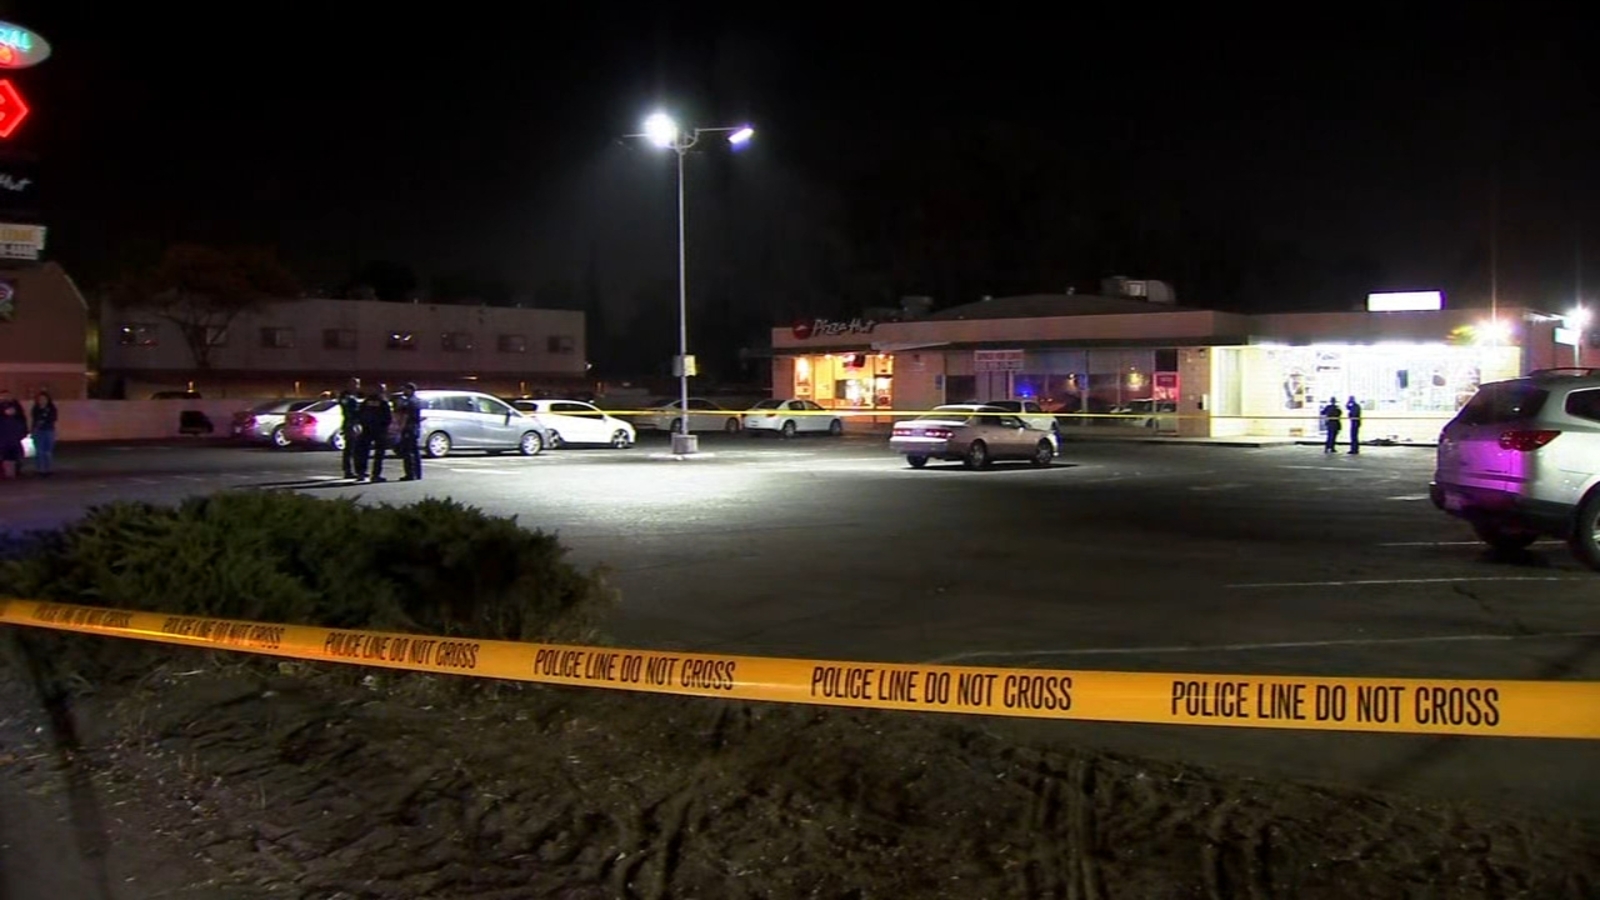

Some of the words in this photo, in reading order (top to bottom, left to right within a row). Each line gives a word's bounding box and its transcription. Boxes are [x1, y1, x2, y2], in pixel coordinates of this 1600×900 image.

[812, 319, 848, 336] Pizza
[849, 318, 877, 334] Hut
[162, 616, 197, 637] POLICE
[249, 625, 285, 649] CROSS
[324, 632, 364, 657] POLICE
[363, 635, 391, 660] LINE
[390, 638, 410, 662] DO
[408, 639, 436, 665] NOT
[435, 641, 480, 669] CROSS
[534, 649, 585, 678] POLICE
[585, 652, 619, 681] LINE
[620, 655, 643, 683] DO
[645, 657, 680, 686] NOT
[680, 659, 736, 690] CROSS
[811, 666, 875, 700] POLICE
[878, 669, 919, 702] LINE
[924, 671, 951, 705] DO
[957, 673, 998, 707] NOT
[1003, 674, 1073, 711] CROSS
[1171, 680, 1250, 718] POLICE
[1256, 683, 1306, 720] LINE
[1315, 684, 1347, 722] DO
[1357, 685, 1405, 723] NOT
[1414, 686, 1500, 727] CROSS
